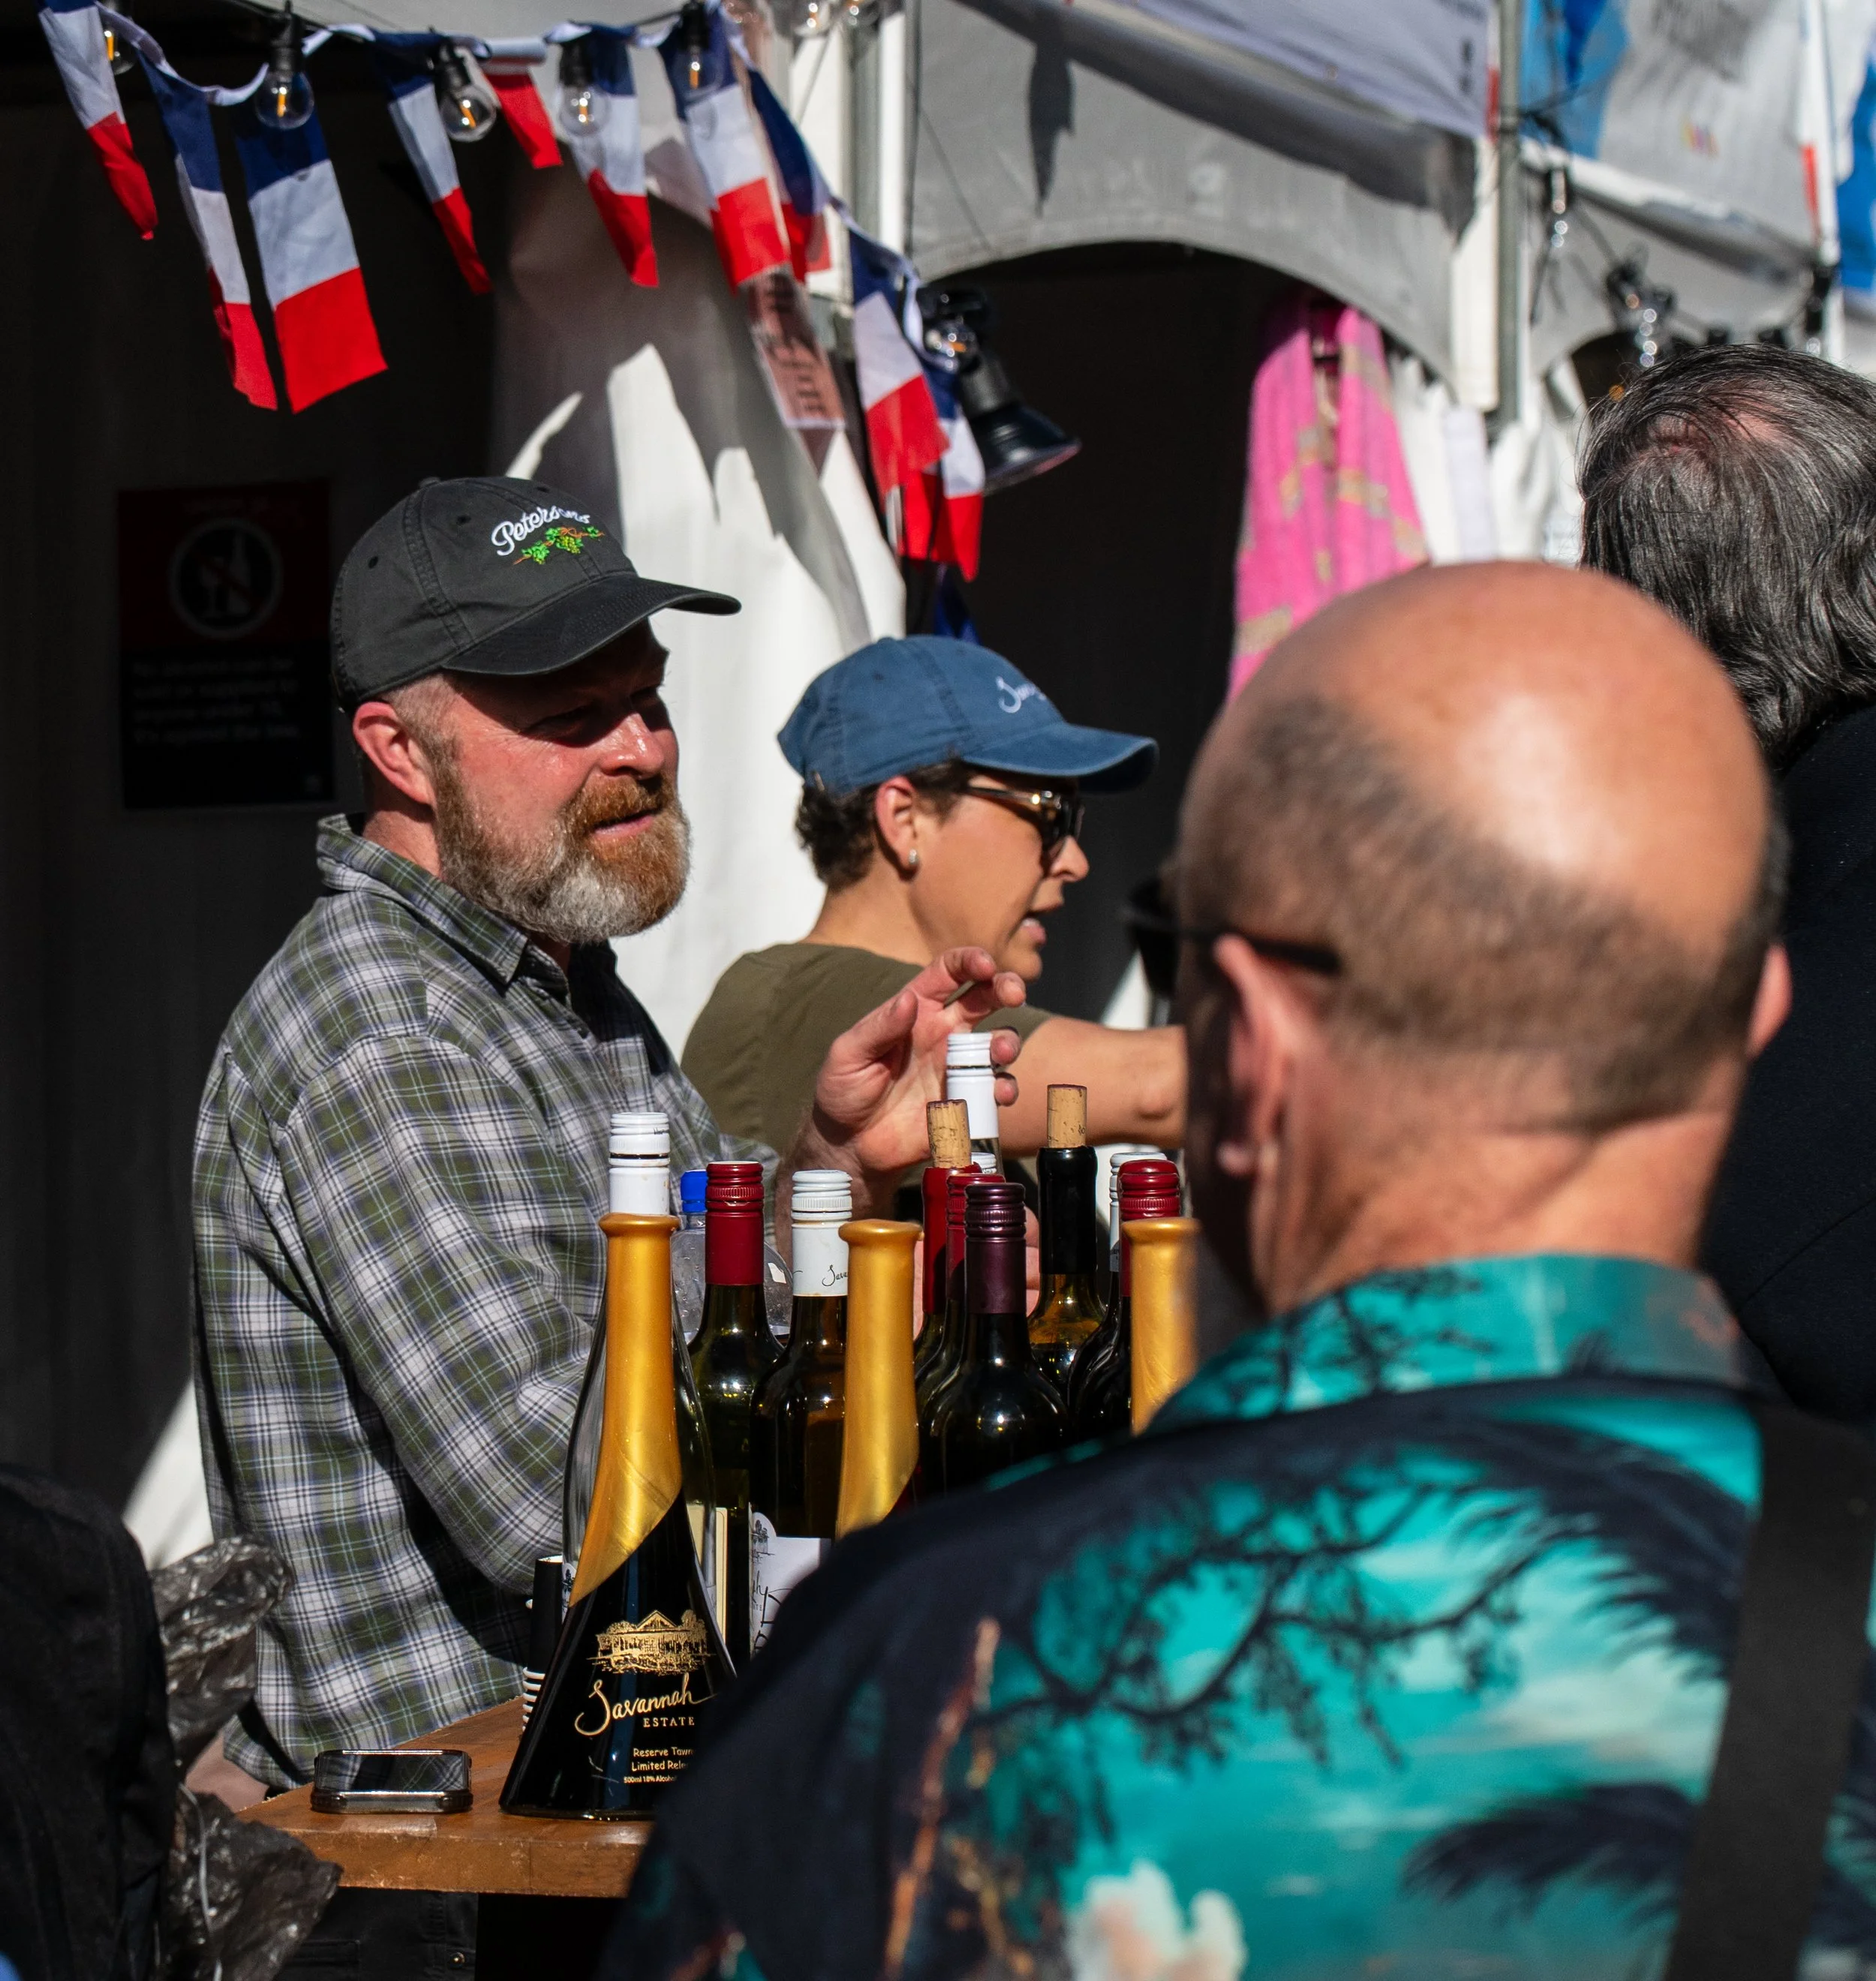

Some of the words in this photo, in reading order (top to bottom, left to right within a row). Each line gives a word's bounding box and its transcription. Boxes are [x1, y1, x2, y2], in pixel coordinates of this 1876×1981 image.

[821, 1264, 848, 1287] Sava
[574, 1672, 718, 1736] Savannah
[642, 1716, 695, 1728] ESTATE
[633, 1748, 669, 1757] Reserve
[671, 1746, 695, 1756] Tawn
[631, 1760, 666, 1772] Limited
[667, 1760, 688, 1770] Rele
